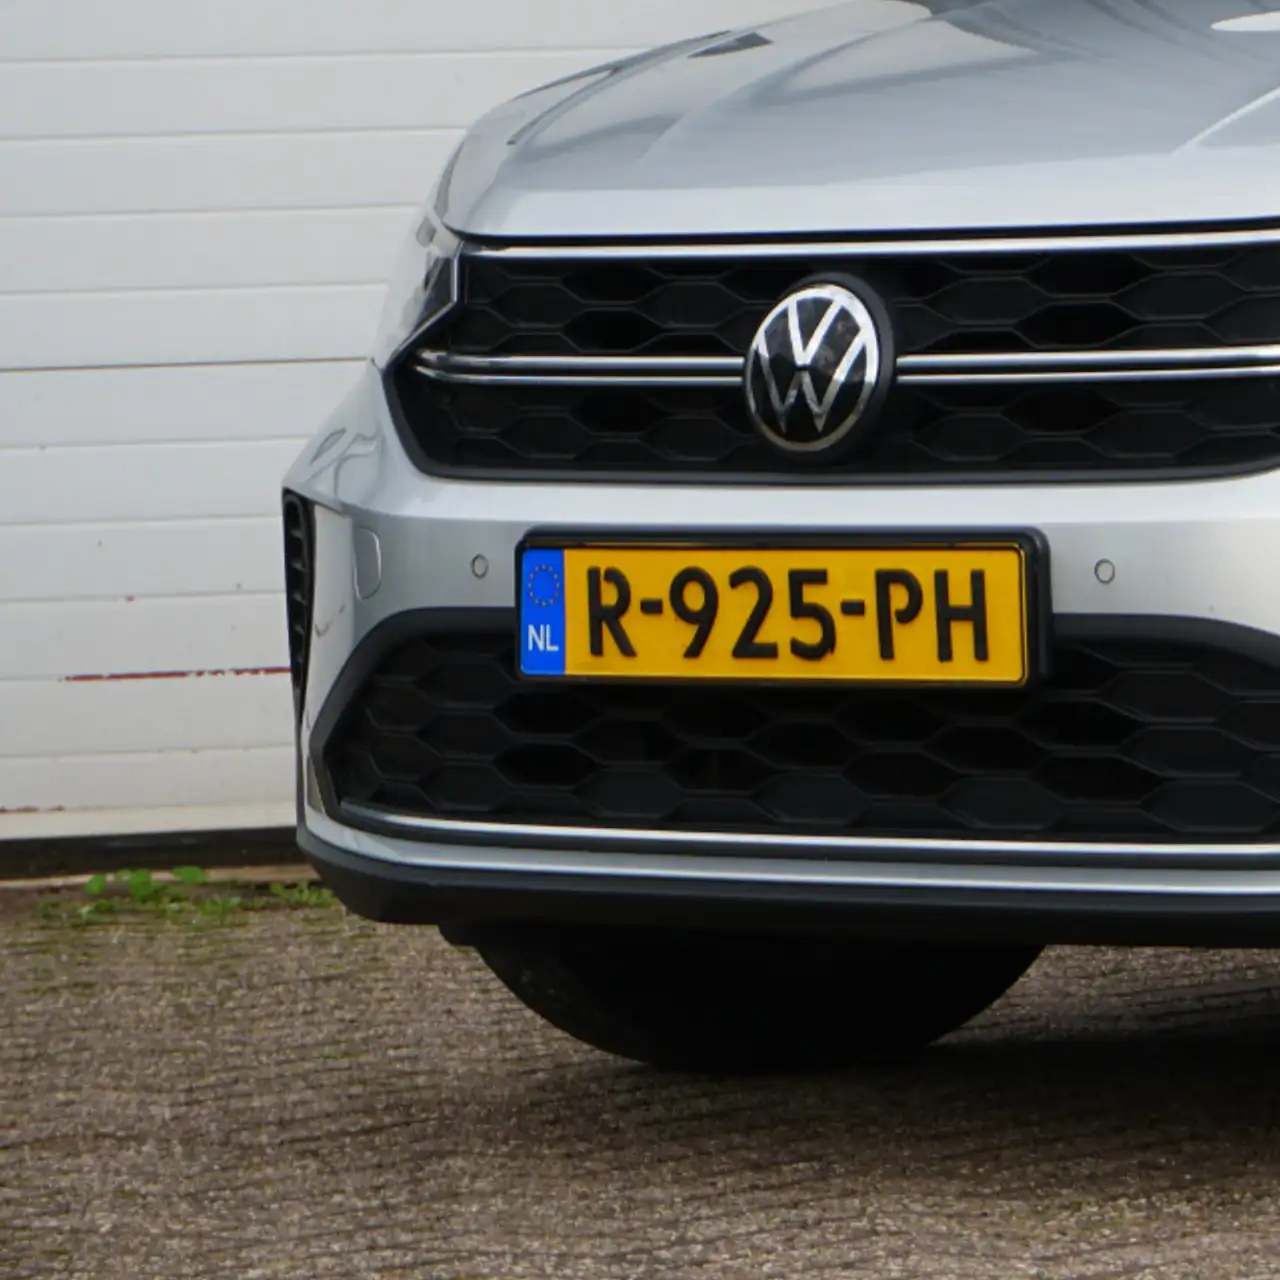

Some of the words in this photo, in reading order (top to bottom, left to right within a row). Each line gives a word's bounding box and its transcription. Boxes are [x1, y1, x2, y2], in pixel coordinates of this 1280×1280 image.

[750, 287, 874, 444] VW
[527, 624, 559, 652] NL
[586, 565, 990, 662] R-925-PH
